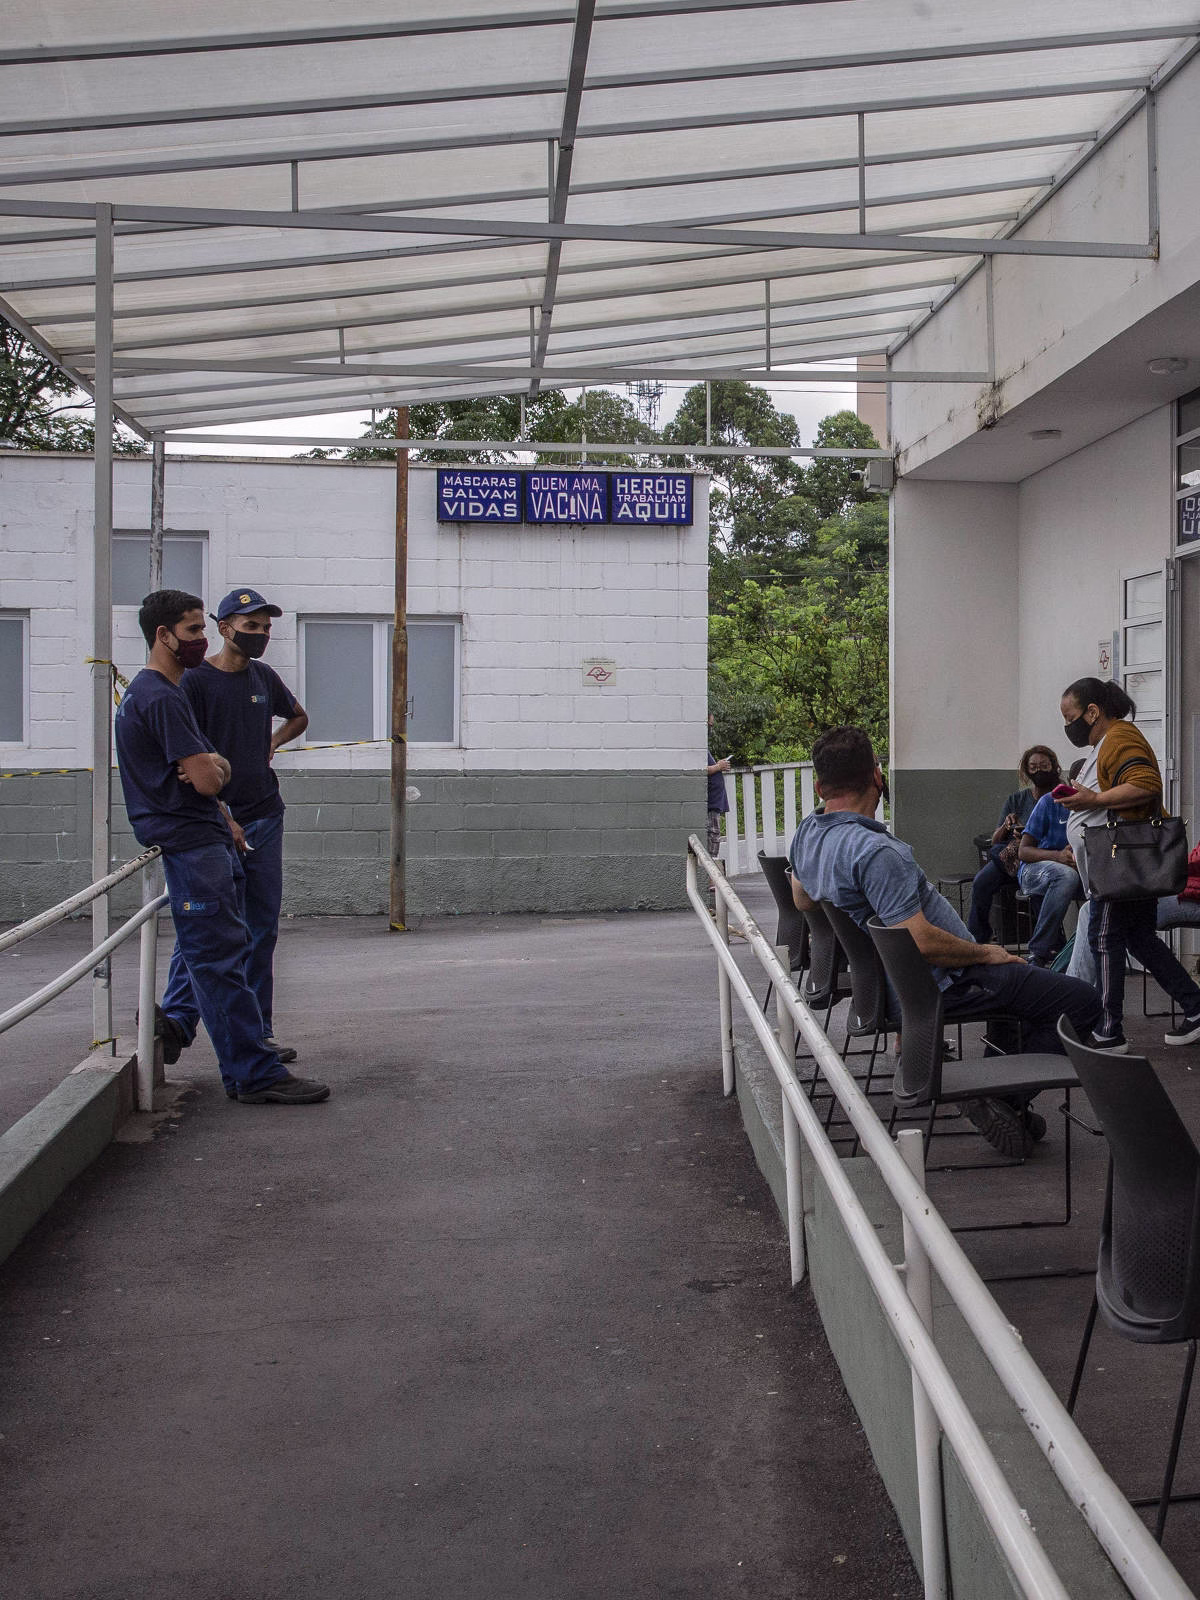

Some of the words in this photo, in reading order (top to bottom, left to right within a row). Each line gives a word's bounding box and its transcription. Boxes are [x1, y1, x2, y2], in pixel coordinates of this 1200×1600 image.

[444, 473, 517, 487] MÁSCARAS
[531, 477, 568, 492] QUEM
[616, 475, 686, 495] HERÓIS
[442, 488, 517, 500] SALVAM
[616, 494, 686, 503] TRABALHAM
[443, 502, 518, 517] VIDAS
[617, 502, 686, 521] AQUI!
